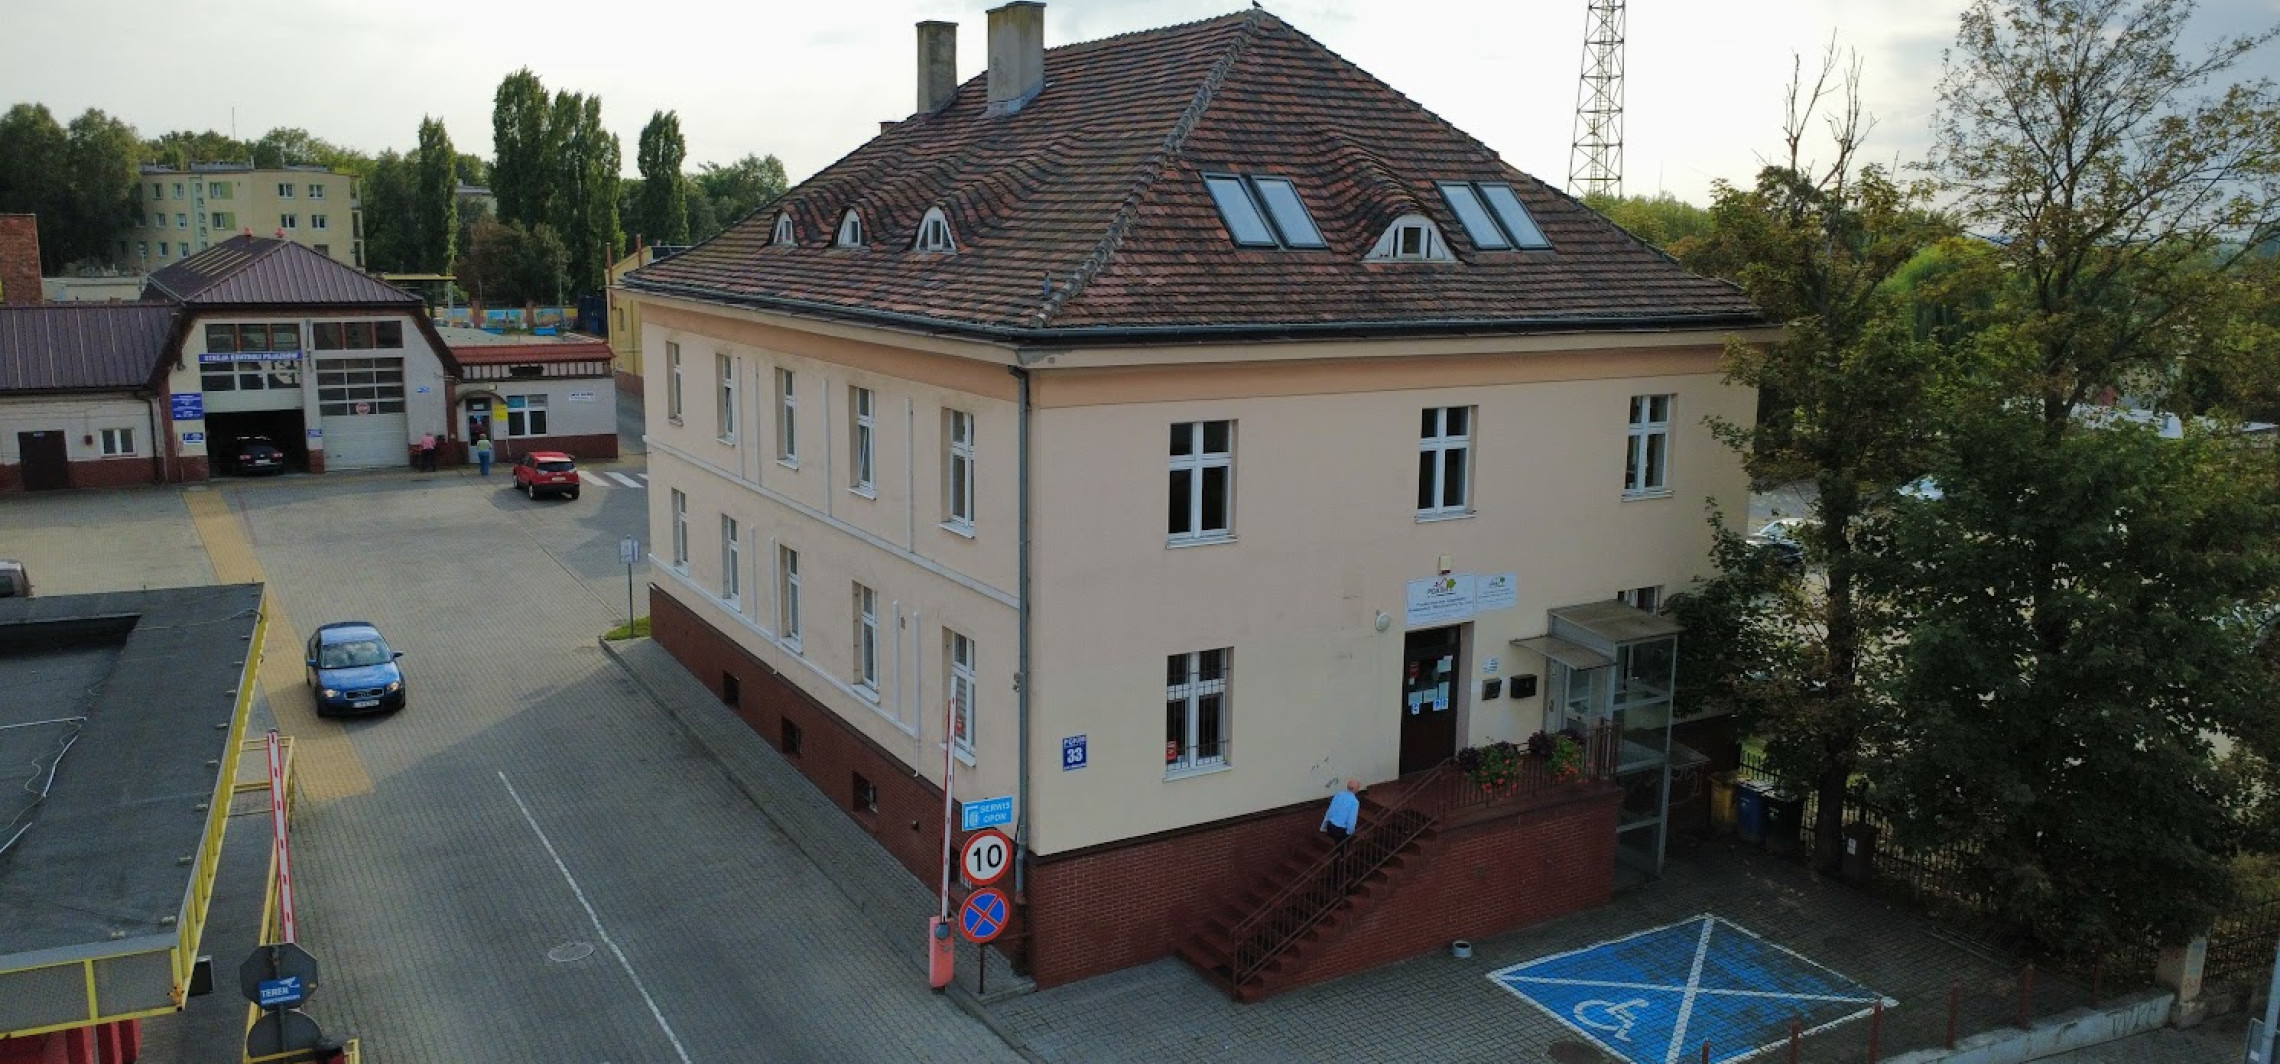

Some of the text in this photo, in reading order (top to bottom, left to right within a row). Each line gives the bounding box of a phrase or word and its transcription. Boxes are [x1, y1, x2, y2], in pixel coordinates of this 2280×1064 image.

[1067, 747, 1083, 763] 33
[979, 801, 1010, 814] SERWIS
[982, 813, 1007, 823] OPON
[973, 844, 1002, 872] 10
[260, 986, 290, 998] TEREN
